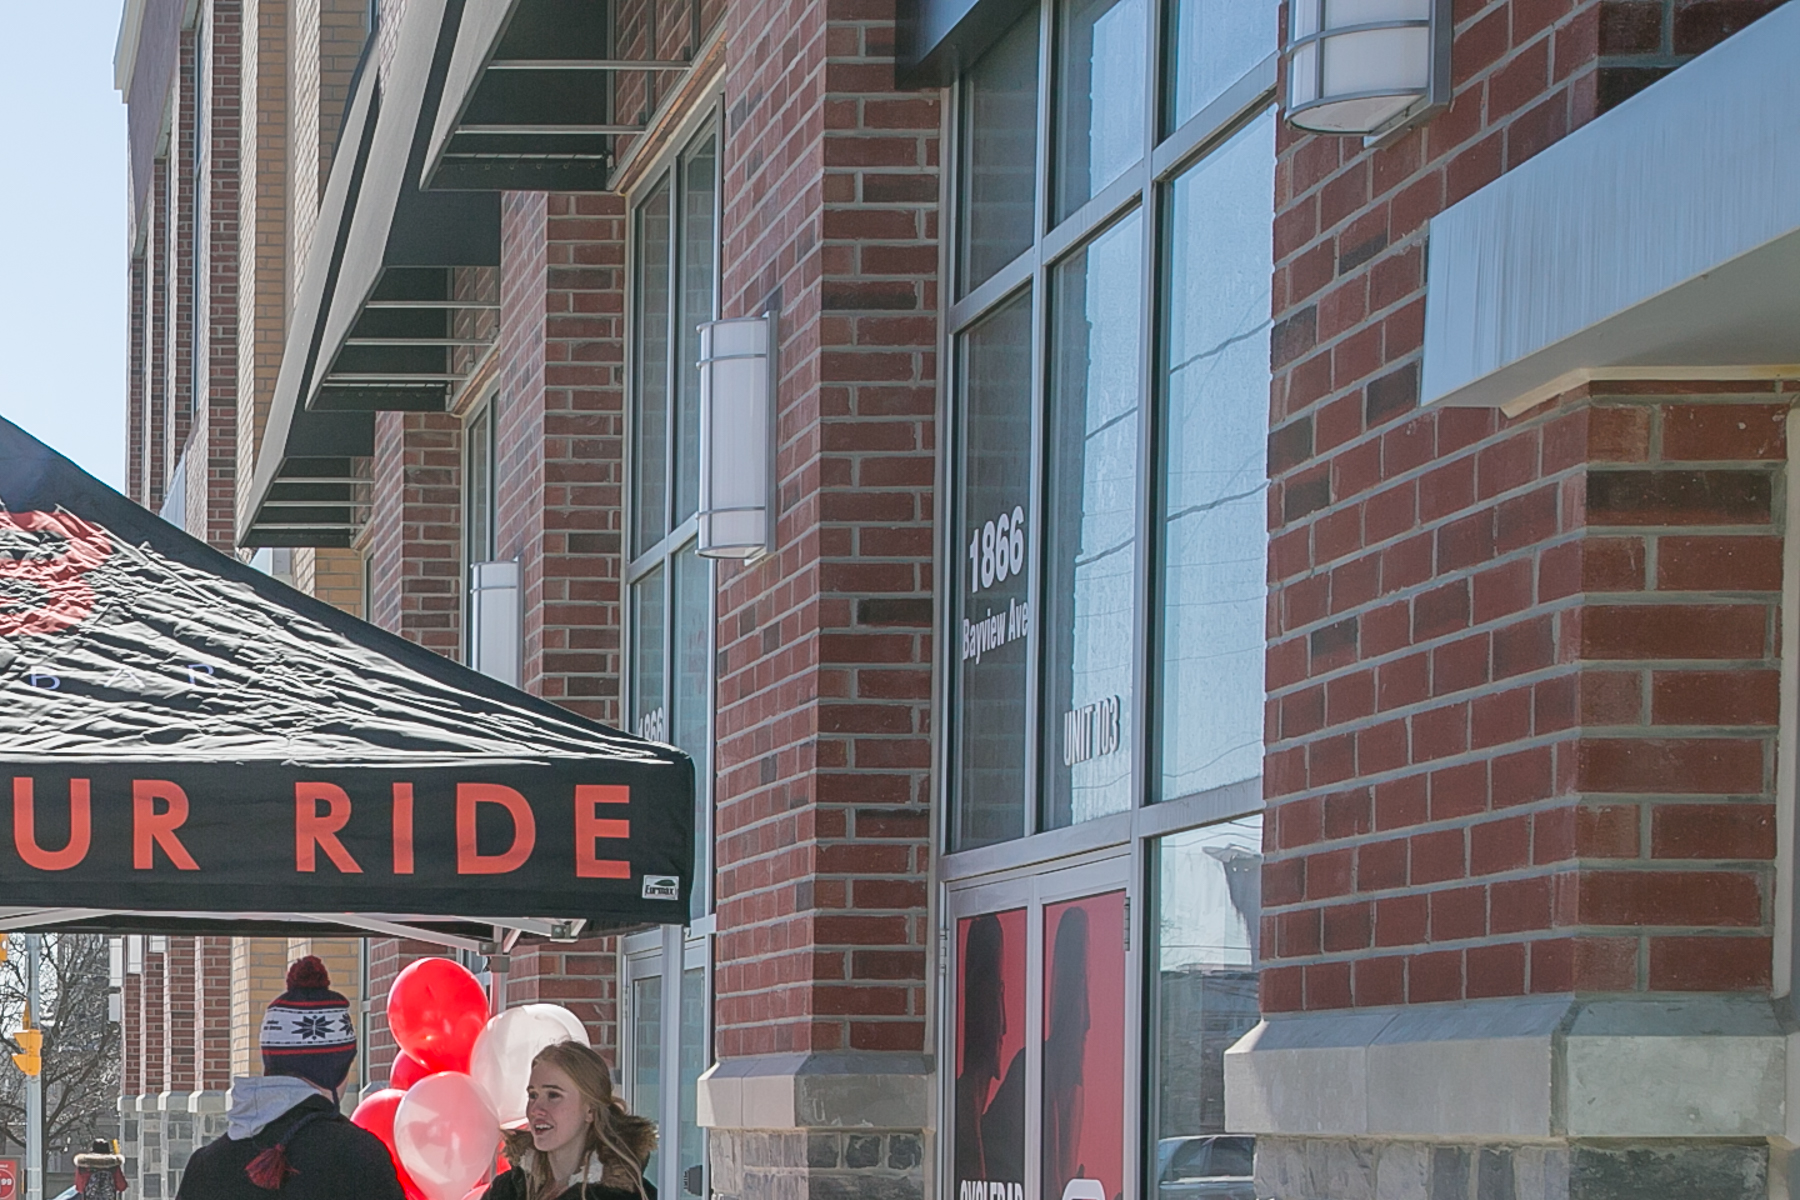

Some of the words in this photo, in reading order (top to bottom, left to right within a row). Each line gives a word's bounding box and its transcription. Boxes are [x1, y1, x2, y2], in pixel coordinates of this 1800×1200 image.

[969, 505, 1025, 594] 1866
[962, 608, 1007, 665] Bayview
[1008, 597, 1030, 643] Ave
[1063, 703, 1094, 767] UNIT
[1092, 694, 1120, 756] 103
[294, 781, 631, 879] RIDE
